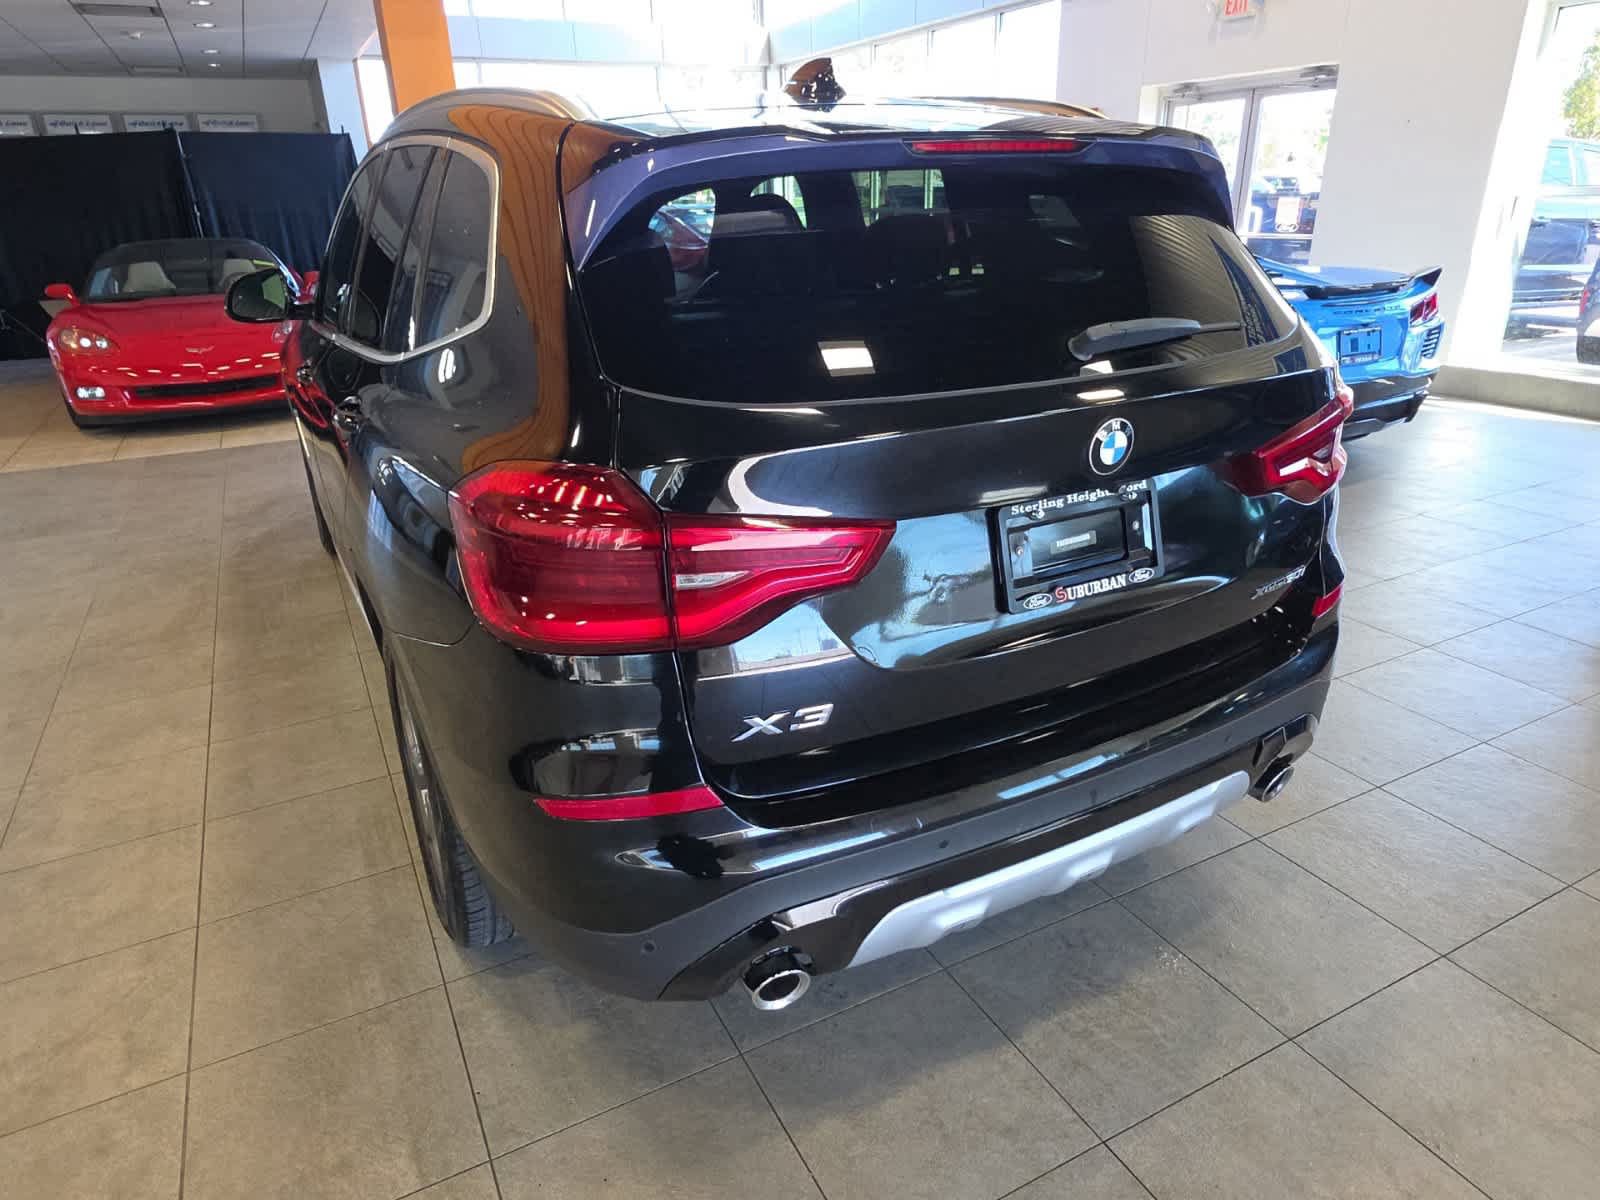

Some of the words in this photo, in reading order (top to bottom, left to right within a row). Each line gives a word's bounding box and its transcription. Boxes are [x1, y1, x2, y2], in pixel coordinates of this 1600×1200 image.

[1011, 498, 1064, 515] Sterling
[1066, 488, 1118, 504] Height
[1055, 574, 1127, 603] SUBURBAN
[731, 703, 834, 742] X3
